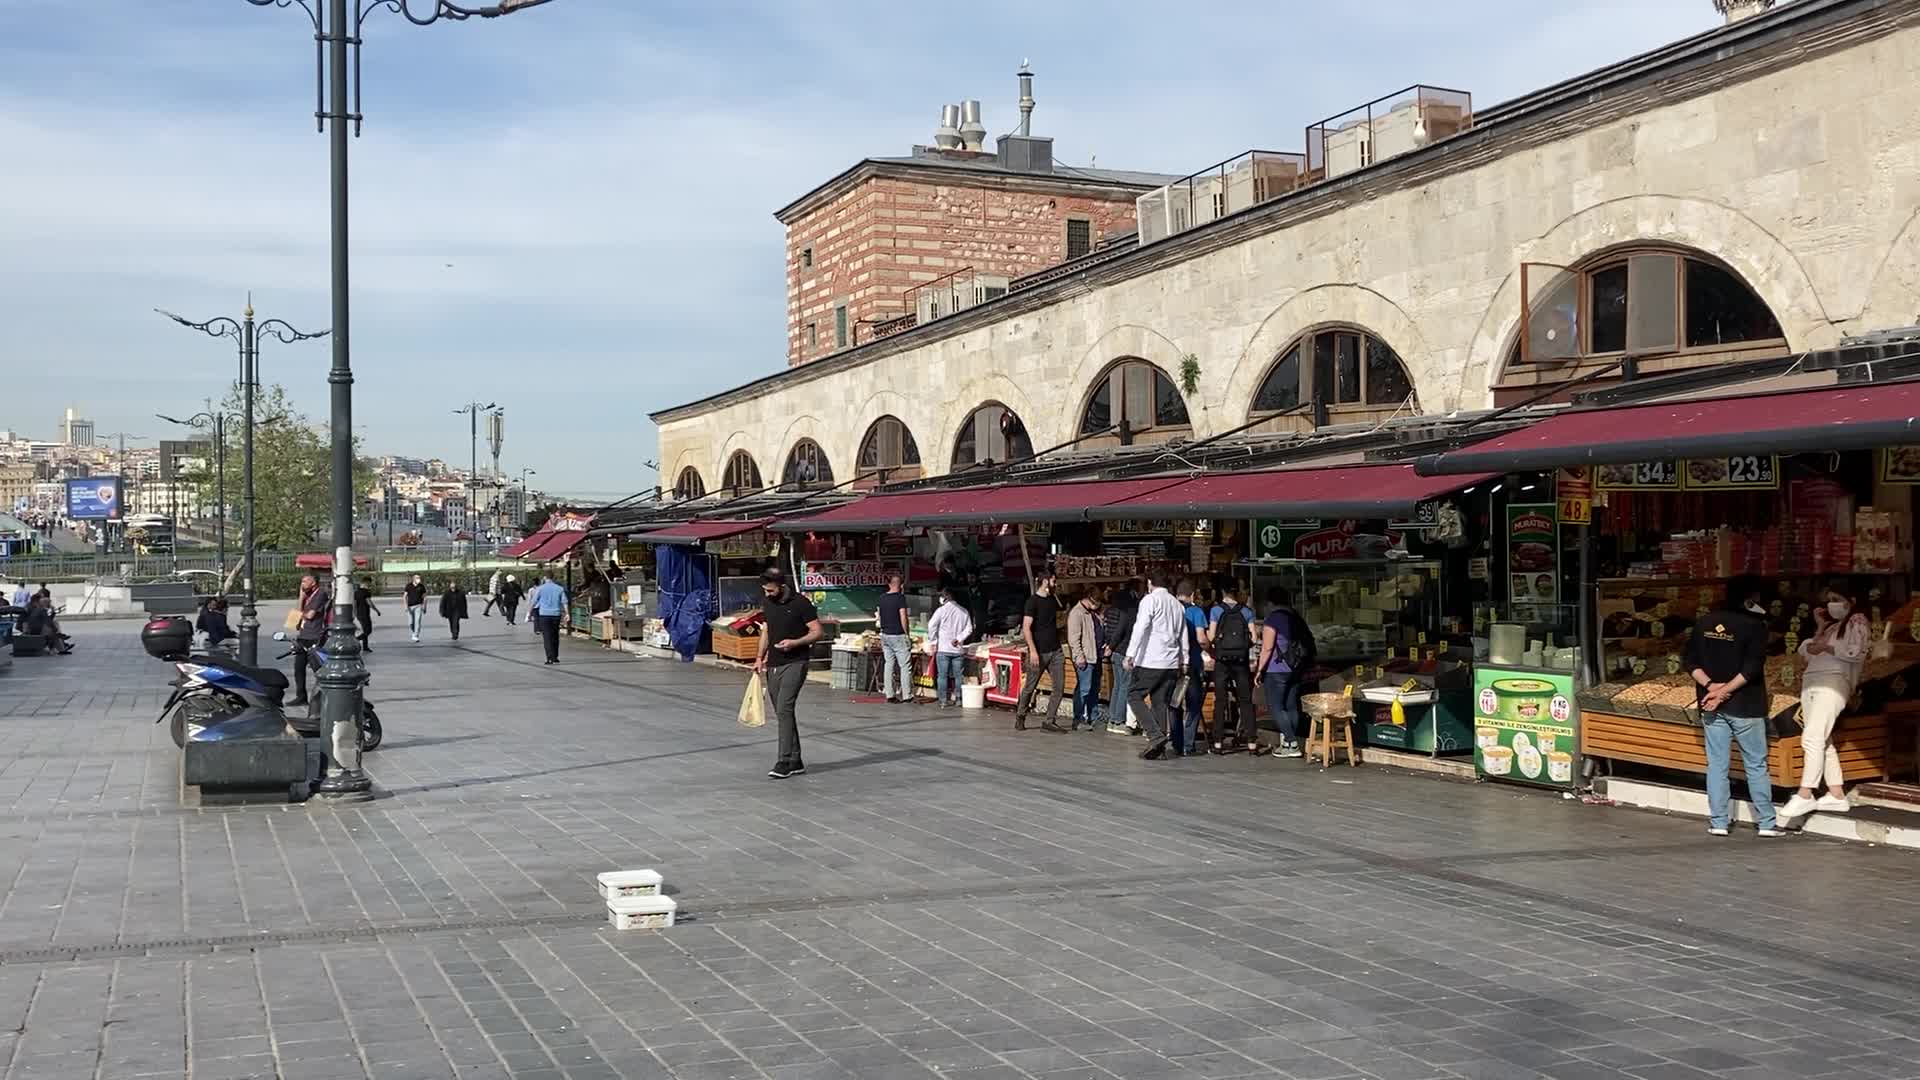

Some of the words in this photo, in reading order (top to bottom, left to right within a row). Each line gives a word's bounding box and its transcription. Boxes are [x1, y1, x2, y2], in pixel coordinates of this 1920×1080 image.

[1639, 462, 1664, 483] 34
[1731, 456, 1760, 482] 23
[1418, 503, 1433, 517] 59
[1564, 501, 1581, 519] 48
[1263, 529, 1278, 546] 13
[848, 562, 880, 573] TAZE
